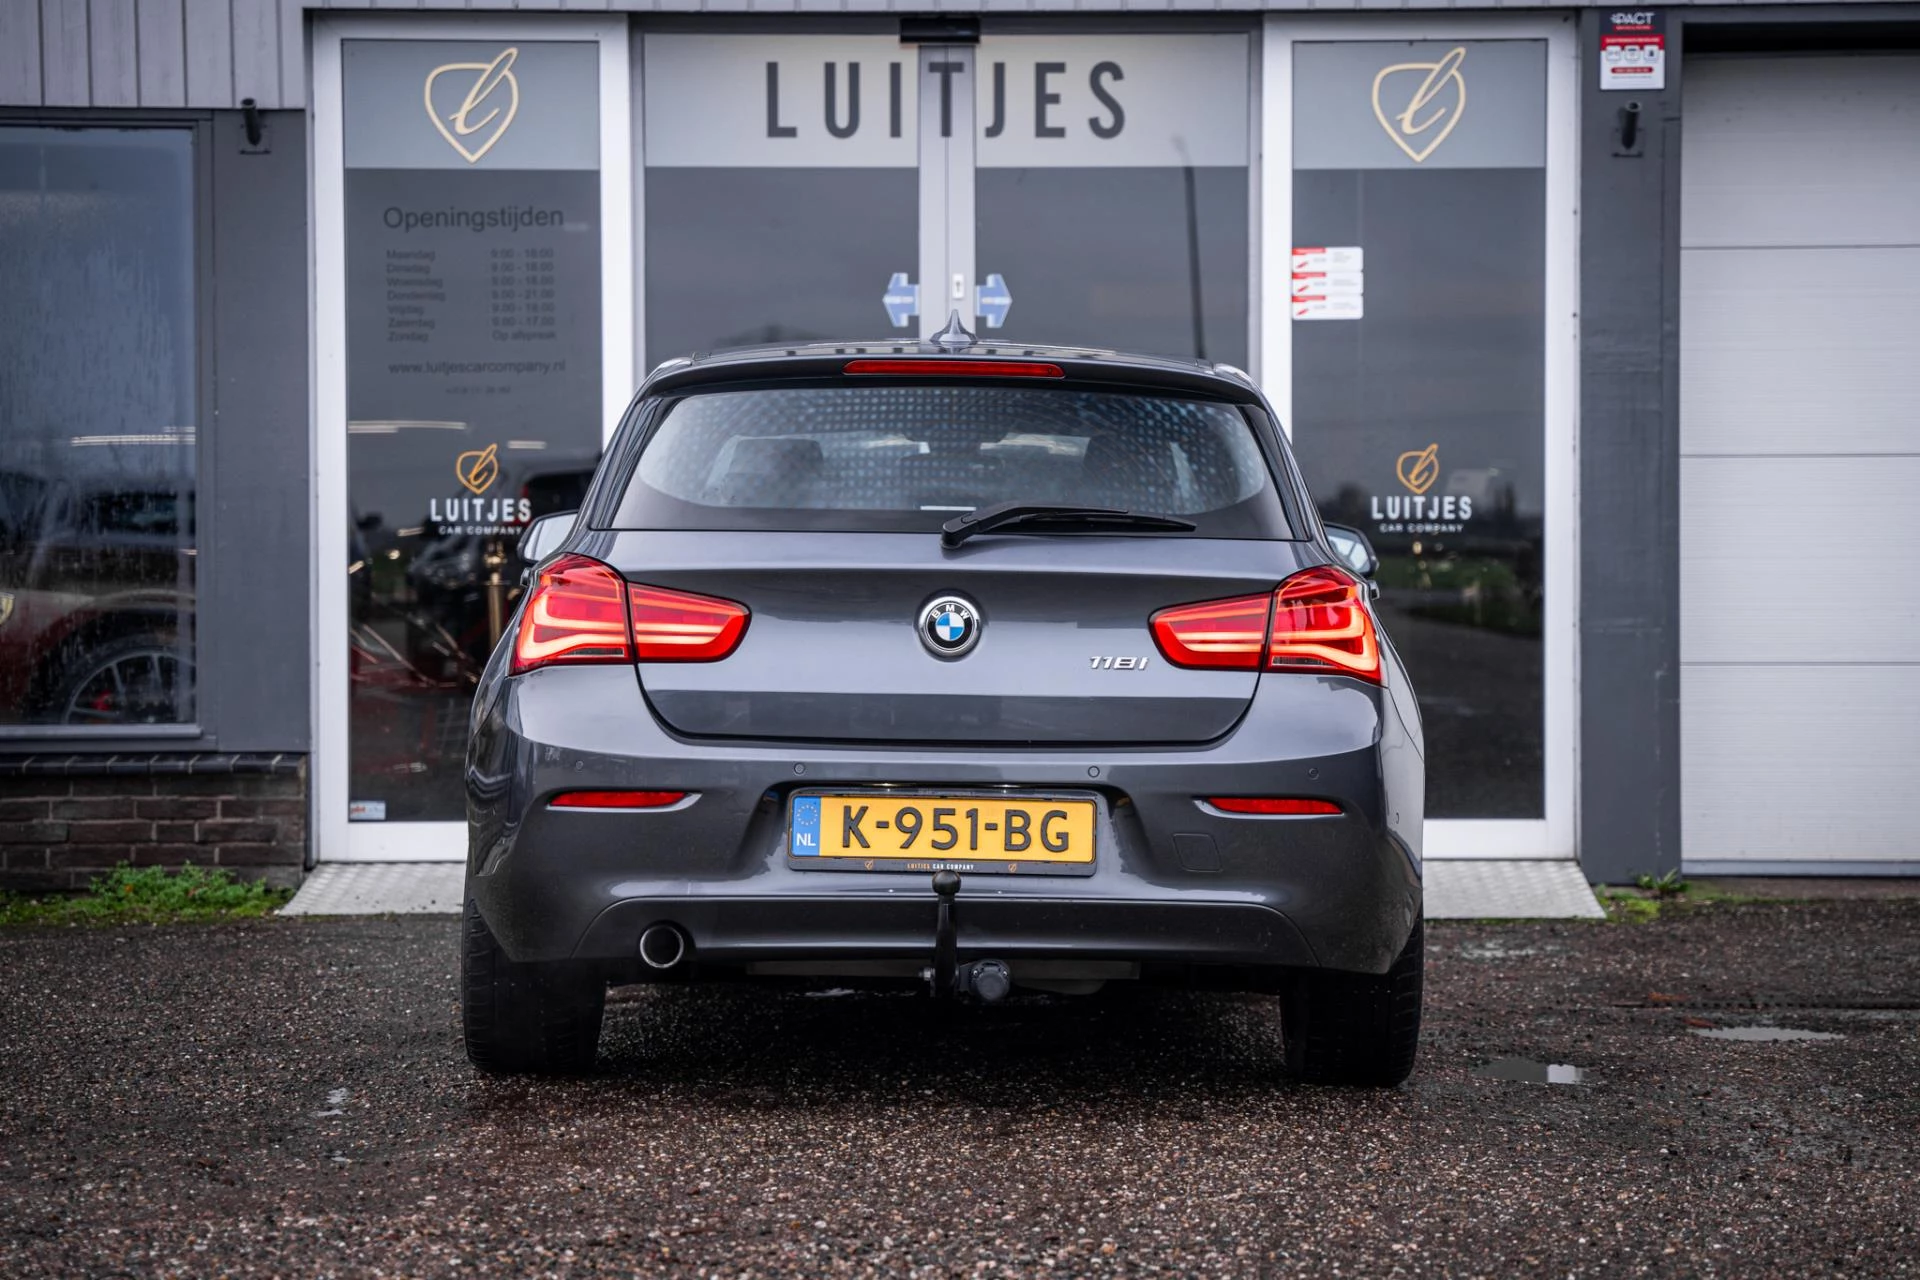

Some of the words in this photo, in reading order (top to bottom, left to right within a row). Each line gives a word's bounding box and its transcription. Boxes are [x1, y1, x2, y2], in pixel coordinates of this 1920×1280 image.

[766, 61, 1125, 139] LUITJES
[383, 206, 565, 232] Openingstijden
[430, 498, 531, 522] LUITJES
[1371, 496, 1472, 520] LUITJES
[438, 525, 462, 535] CAR
[467, 525, 522, 535] COMPANY
[1379, 523, 1404, 533] CAR
[1407, 523, 1463, 533] COMPANY
[931, 604, 970, 619] BMW
[796, 833, 816, 846] NL
[842, 805, 1069, 852] K-951-BG
